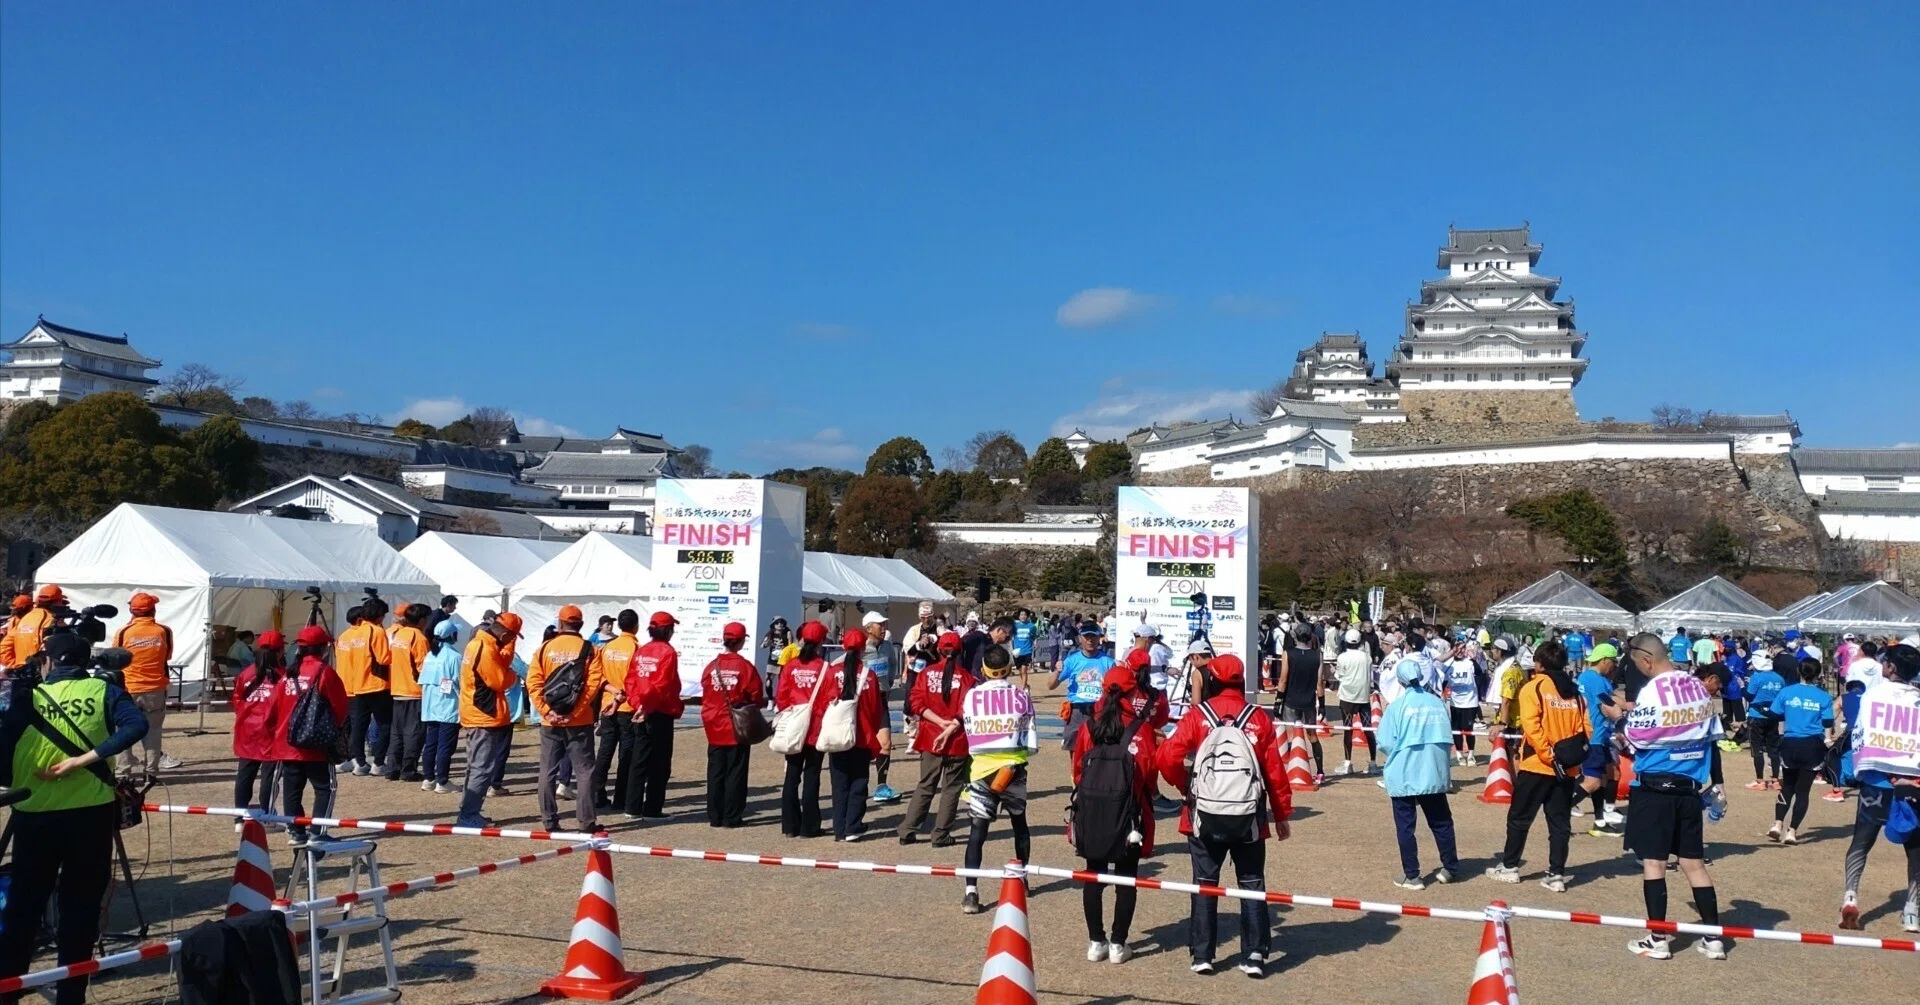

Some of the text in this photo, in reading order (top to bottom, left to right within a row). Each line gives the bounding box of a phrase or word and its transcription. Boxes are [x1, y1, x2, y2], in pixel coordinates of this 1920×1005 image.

[732, 509, 752, 517] 2026
[1211, 519, 1236, 528] 2026
[664, 524, 751, 546] FINISH
[1130, 534, 1235, 558] FINISH
[1630, 706, 1657, 718] CASTLE
[1634, 719, 1657, 728] 2026
[1870, 702, 1920, 736] FINI
